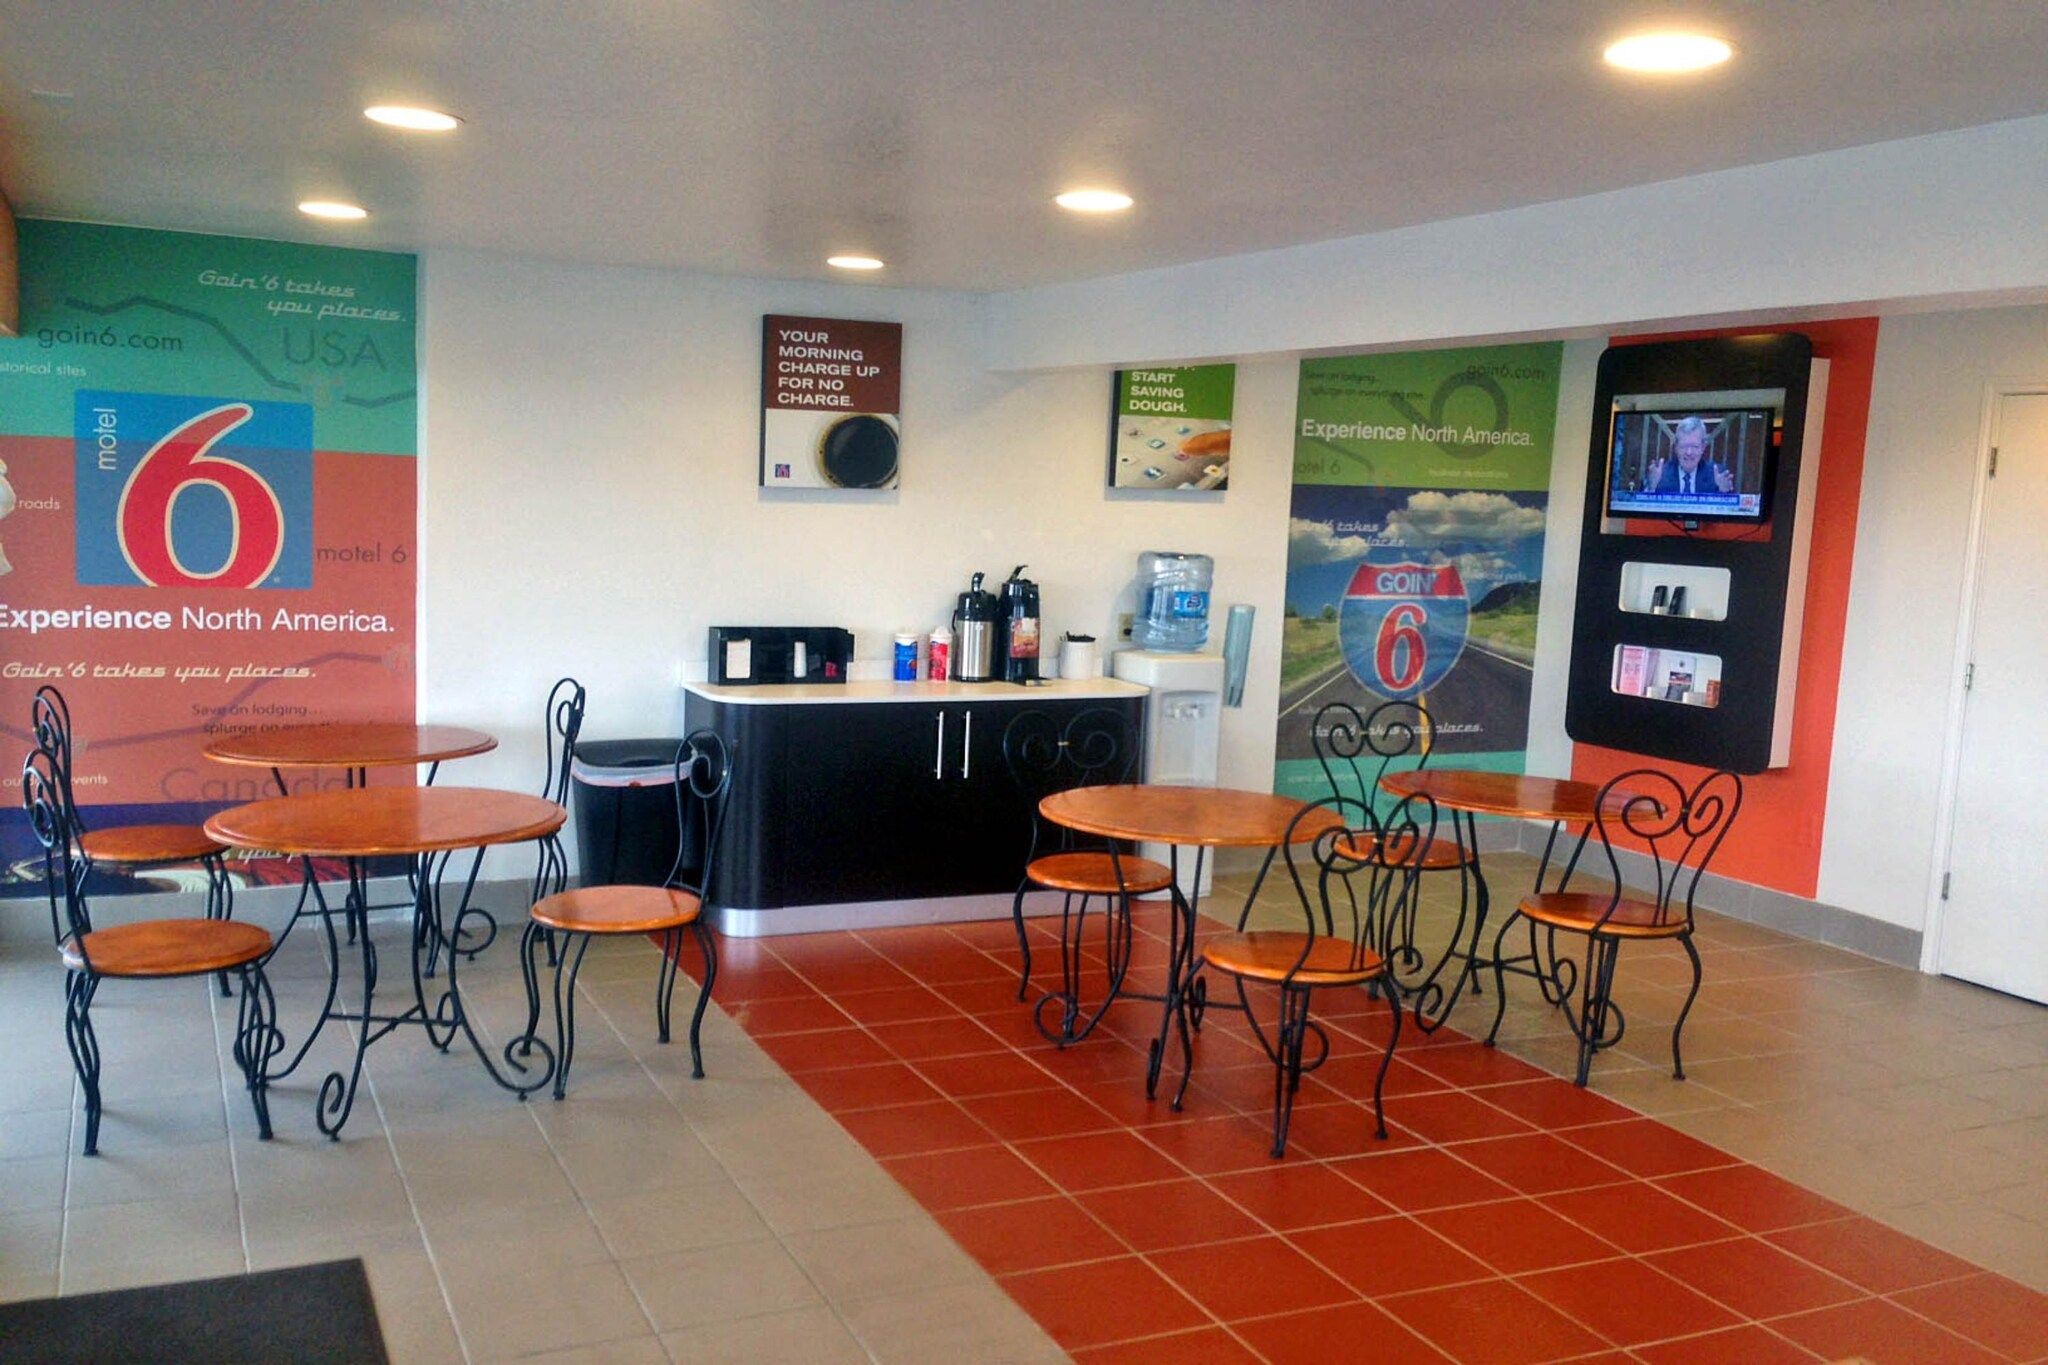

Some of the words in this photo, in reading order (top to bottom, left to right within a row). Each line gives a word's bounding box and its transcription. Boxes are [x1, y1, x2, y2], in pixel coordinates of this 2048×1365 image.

[284, 278, 356, 298] takes
[266, 300, 313, 316] you
[317, 302, 407, 322] places.
[37, 323, 185, 351] goin6.com
[778, 329, 829, 344] YOUR
[281, 326, 387, 371] USA
[778, 346, 864, 361] MORNING
[778, 361, 851, 376] CHARGE
[856, 366, 881, 377] UP
[1131, 371, 1176, 383] START
[778, 377, 814, 390] FOR
[818, 379, 844, 391] NO
[1130, 385, 1184, 398] SAVING
[777, 392, 854, 407] CHARGE.
[1129, 400, 1187, 413] DOUGH.
[93, 407, 117, 471] motel
[1301, 419, 1407, 443] Experience
[1411, 423, 1458, 443] North
[1462, 426, 1535, 447] America.
[18, 496, 61, 511] roads
[117, 402, 284, 589] 6
[317, 545, 381, 564] motel
[392, 546, 408, 565] 6
[0, 604, 172, 634] Experience
[182, 606, 262, 631] North
[271, 607, 395, 633] America.
[1374, 601, 1428, 691] 6
[93, 662, 166, 678] takes
[174, 666, 221, 683] you
[225, 662, 317, 684] places.
[230, 704, 249, 716] on
